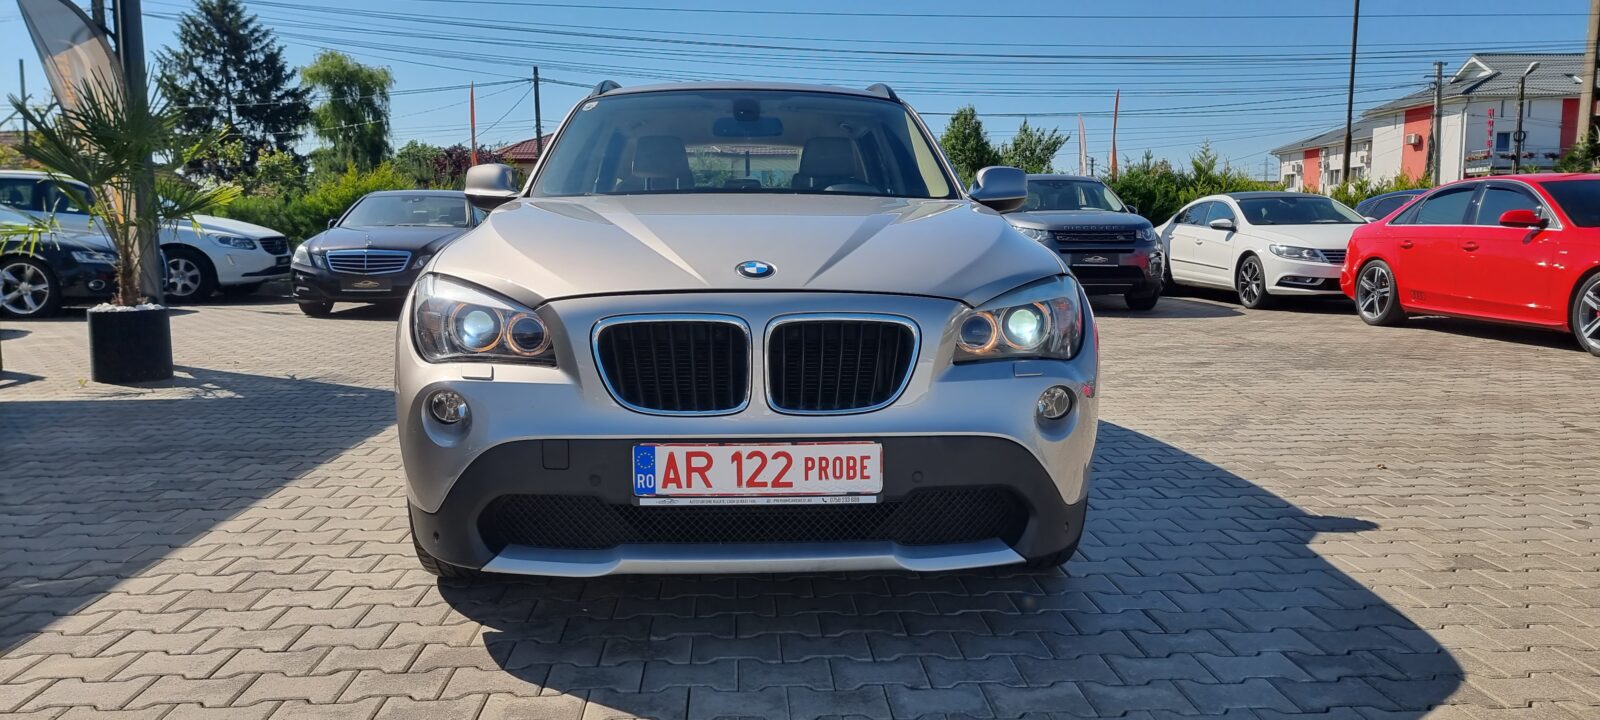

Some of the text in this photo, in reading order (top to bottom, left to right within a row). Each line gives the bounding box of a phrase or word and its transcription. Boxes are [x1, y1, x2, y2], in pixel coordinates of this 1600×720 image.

[637, 474, 655, 488] RO
[661, 450, 871, 489] AR 122 PROBE
